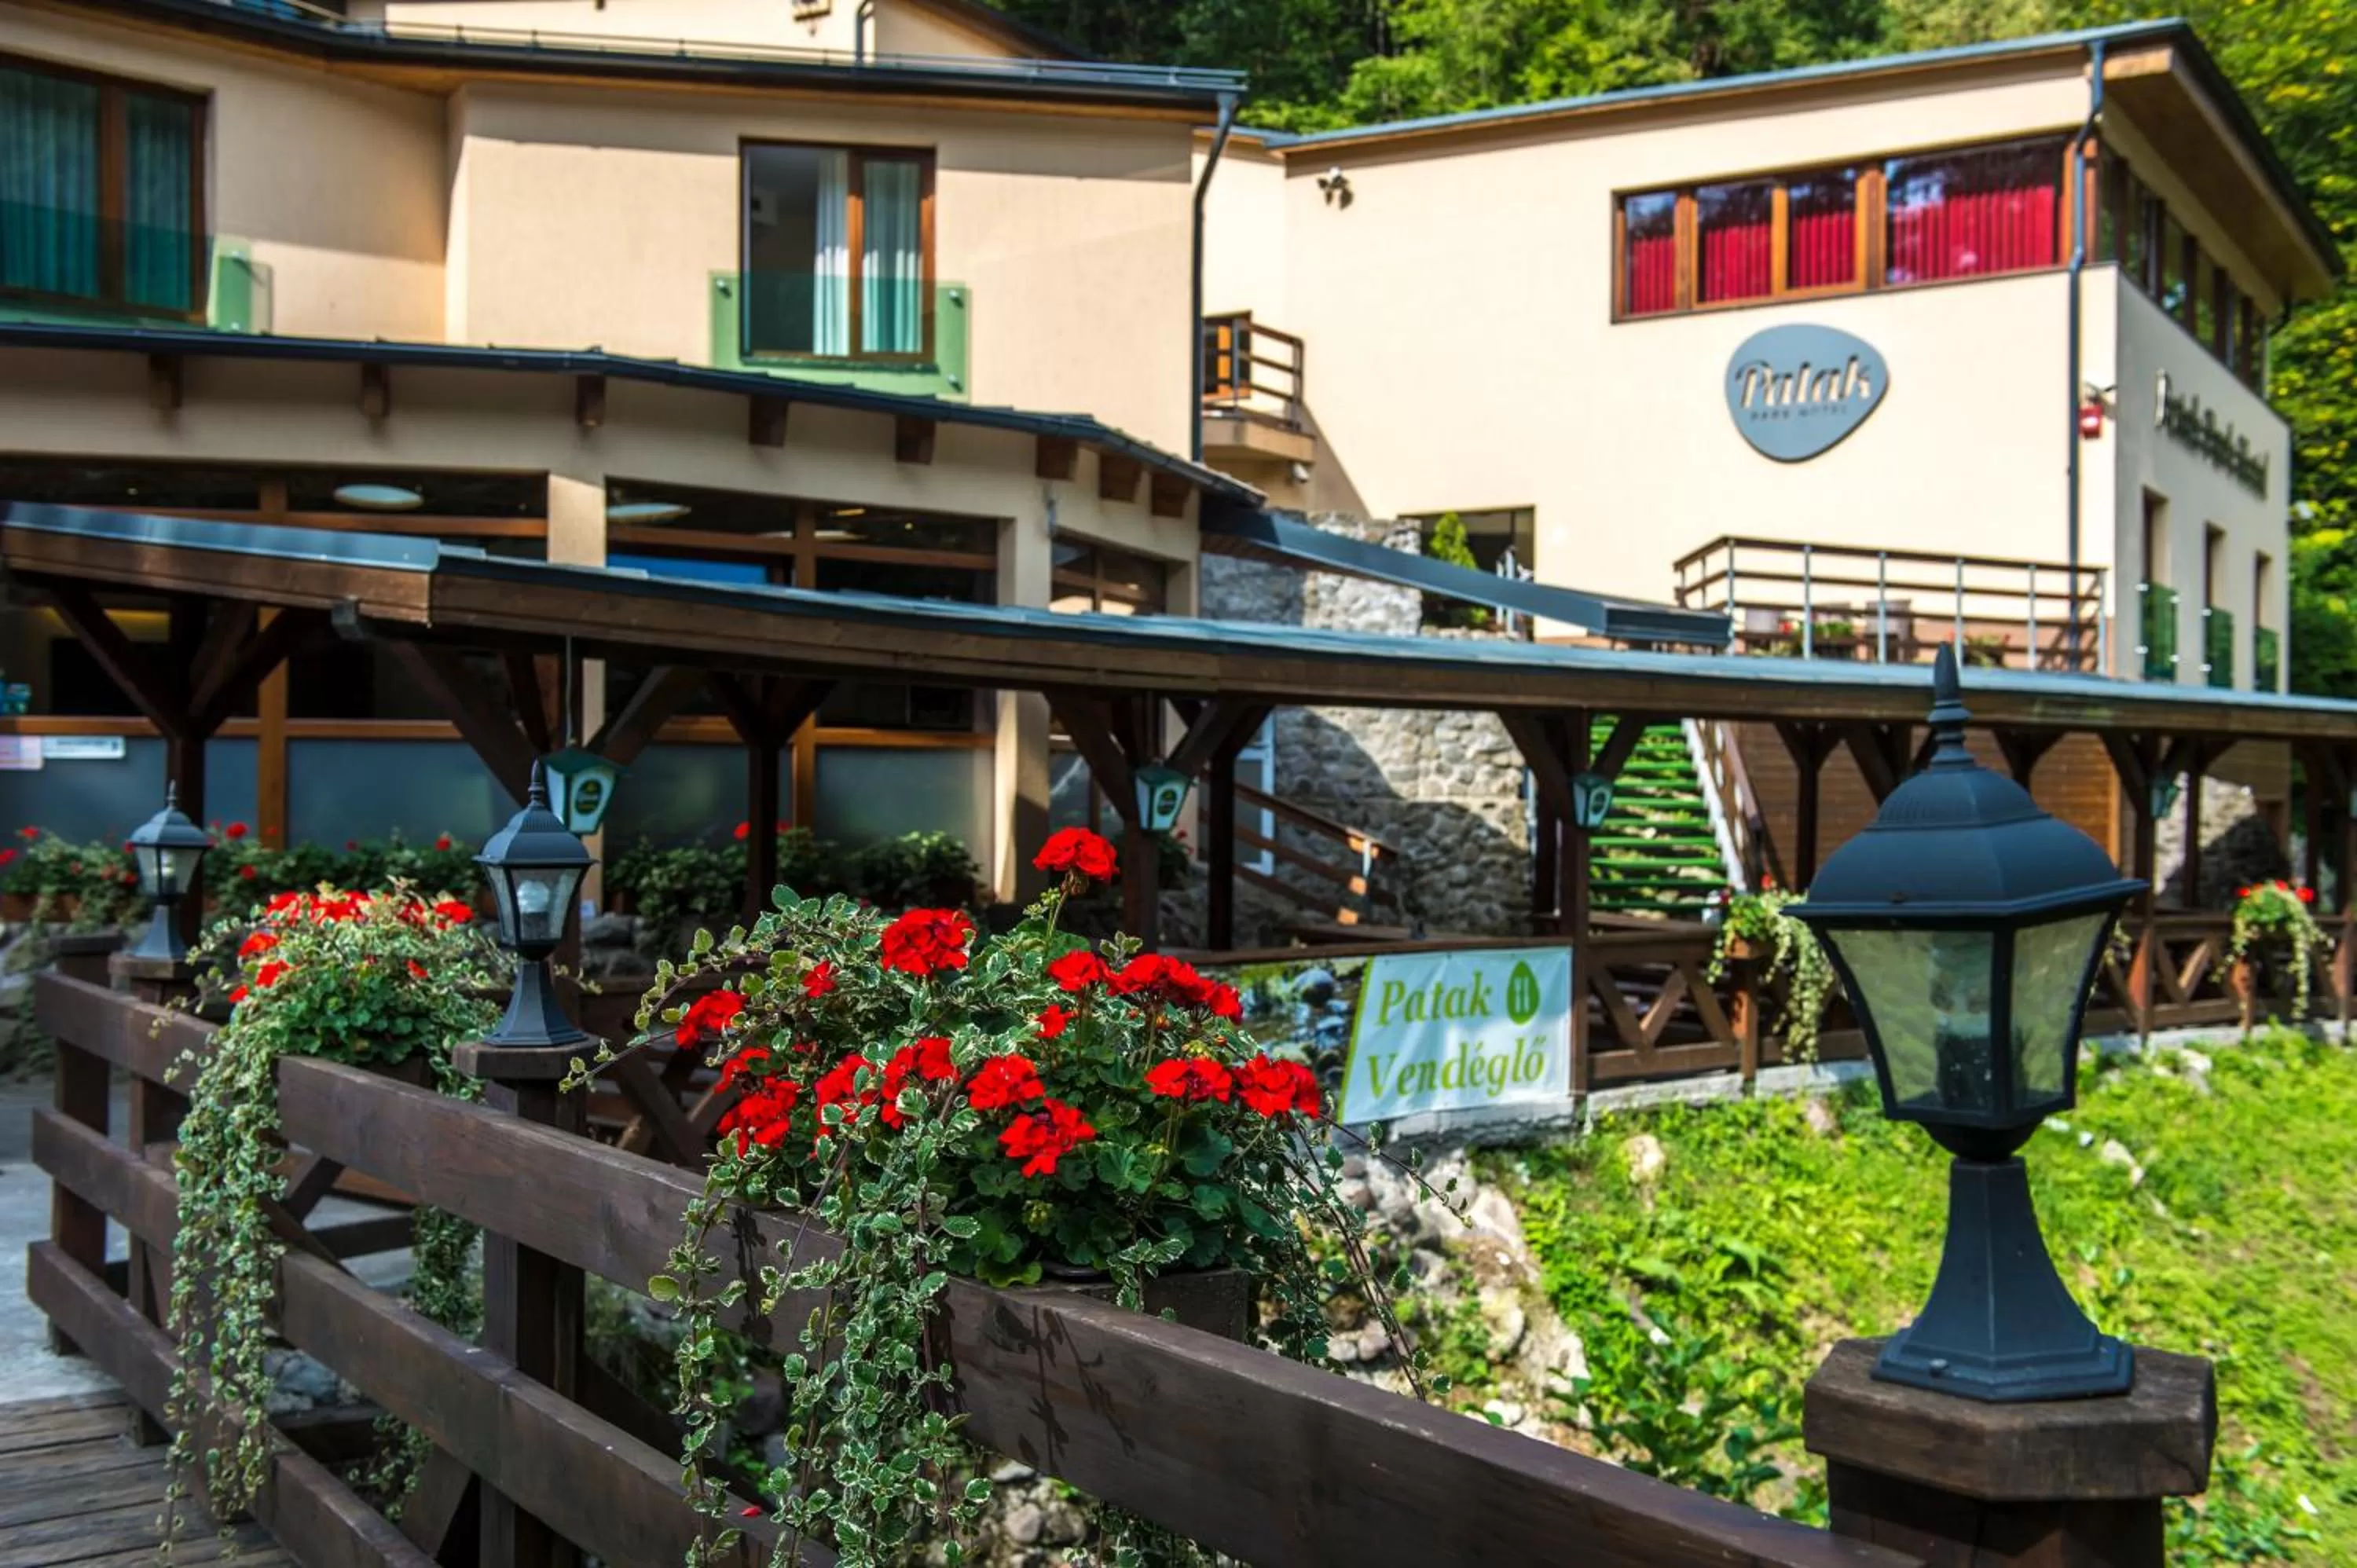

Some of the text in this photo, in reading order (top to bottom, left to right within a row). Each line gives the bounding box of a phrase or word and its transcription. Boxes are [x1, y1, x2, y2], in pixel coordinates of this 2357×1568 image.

[1735, 354, 1871, 409] Patak
[1376, 969, 1491, 1028] Patak
[1367, 1035, 1547, 1098] Vendéglő
